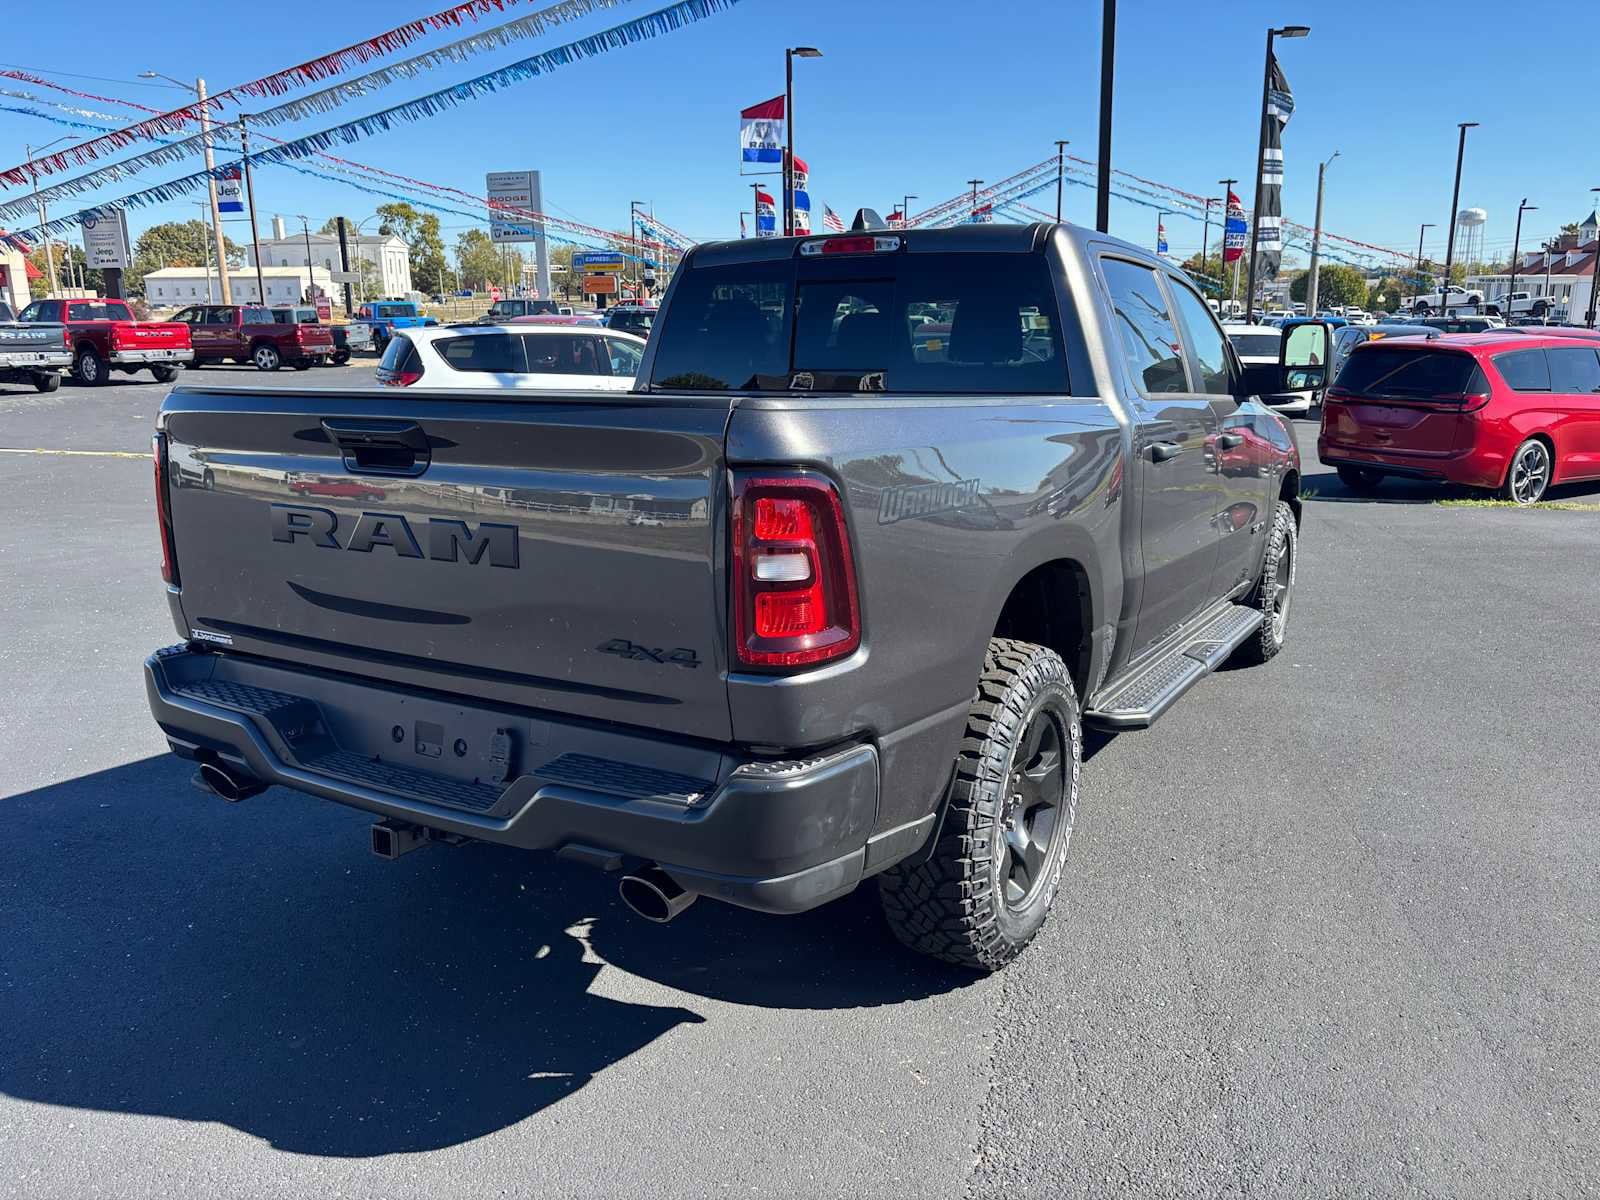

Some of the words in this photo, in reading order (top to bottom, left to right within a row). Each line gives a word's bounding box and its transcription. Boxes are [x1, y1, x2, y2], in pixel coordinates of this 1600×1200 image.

[217, 185, 240, 197] Jeep
[270, 503, 520, 569] RAM
[1044, 722, 1079, 907] GOODYEAR
